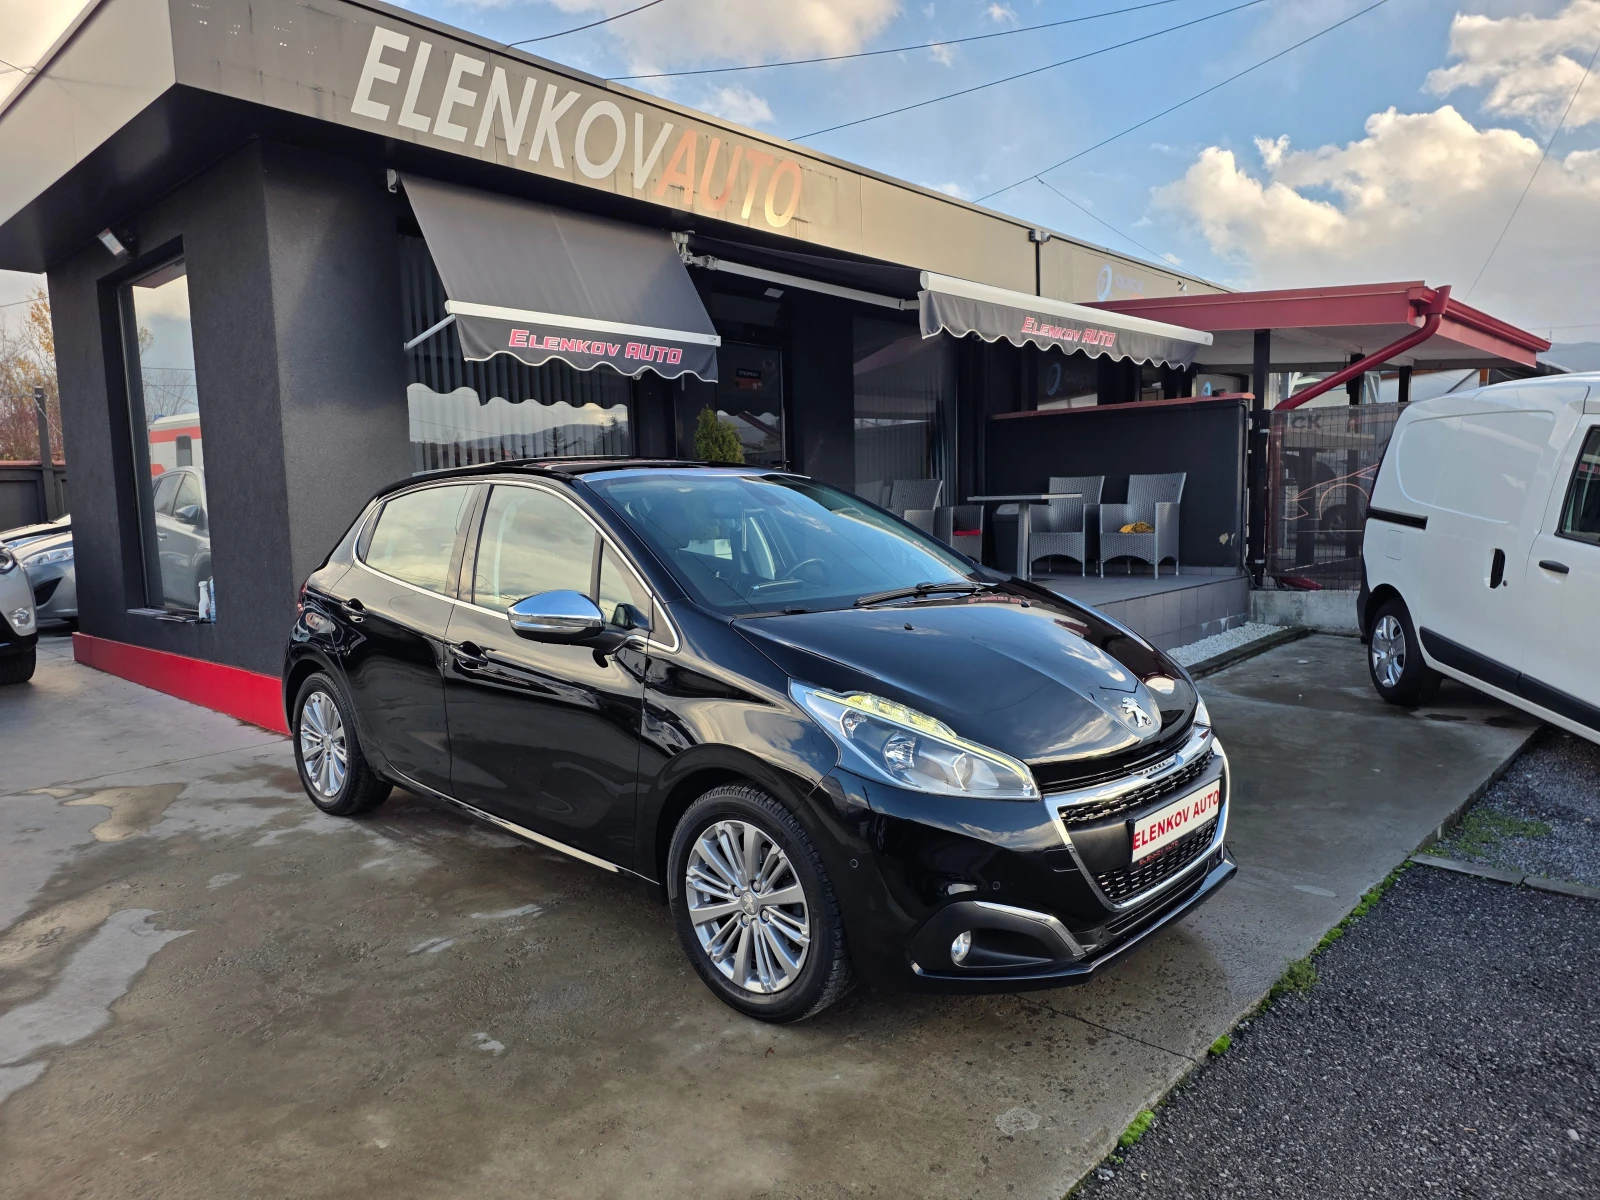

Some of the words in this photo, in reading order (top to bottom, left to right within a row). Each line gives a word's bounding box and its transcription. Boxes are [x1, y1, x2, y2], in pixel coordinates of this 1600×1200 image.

[1082, 328, 1116, 347] AUTO
[624, 342, 683, 364] AUTO
[1133, 806, 1190, 851] ELENKOV
[1193, 789, 1220, 818] AUTO
